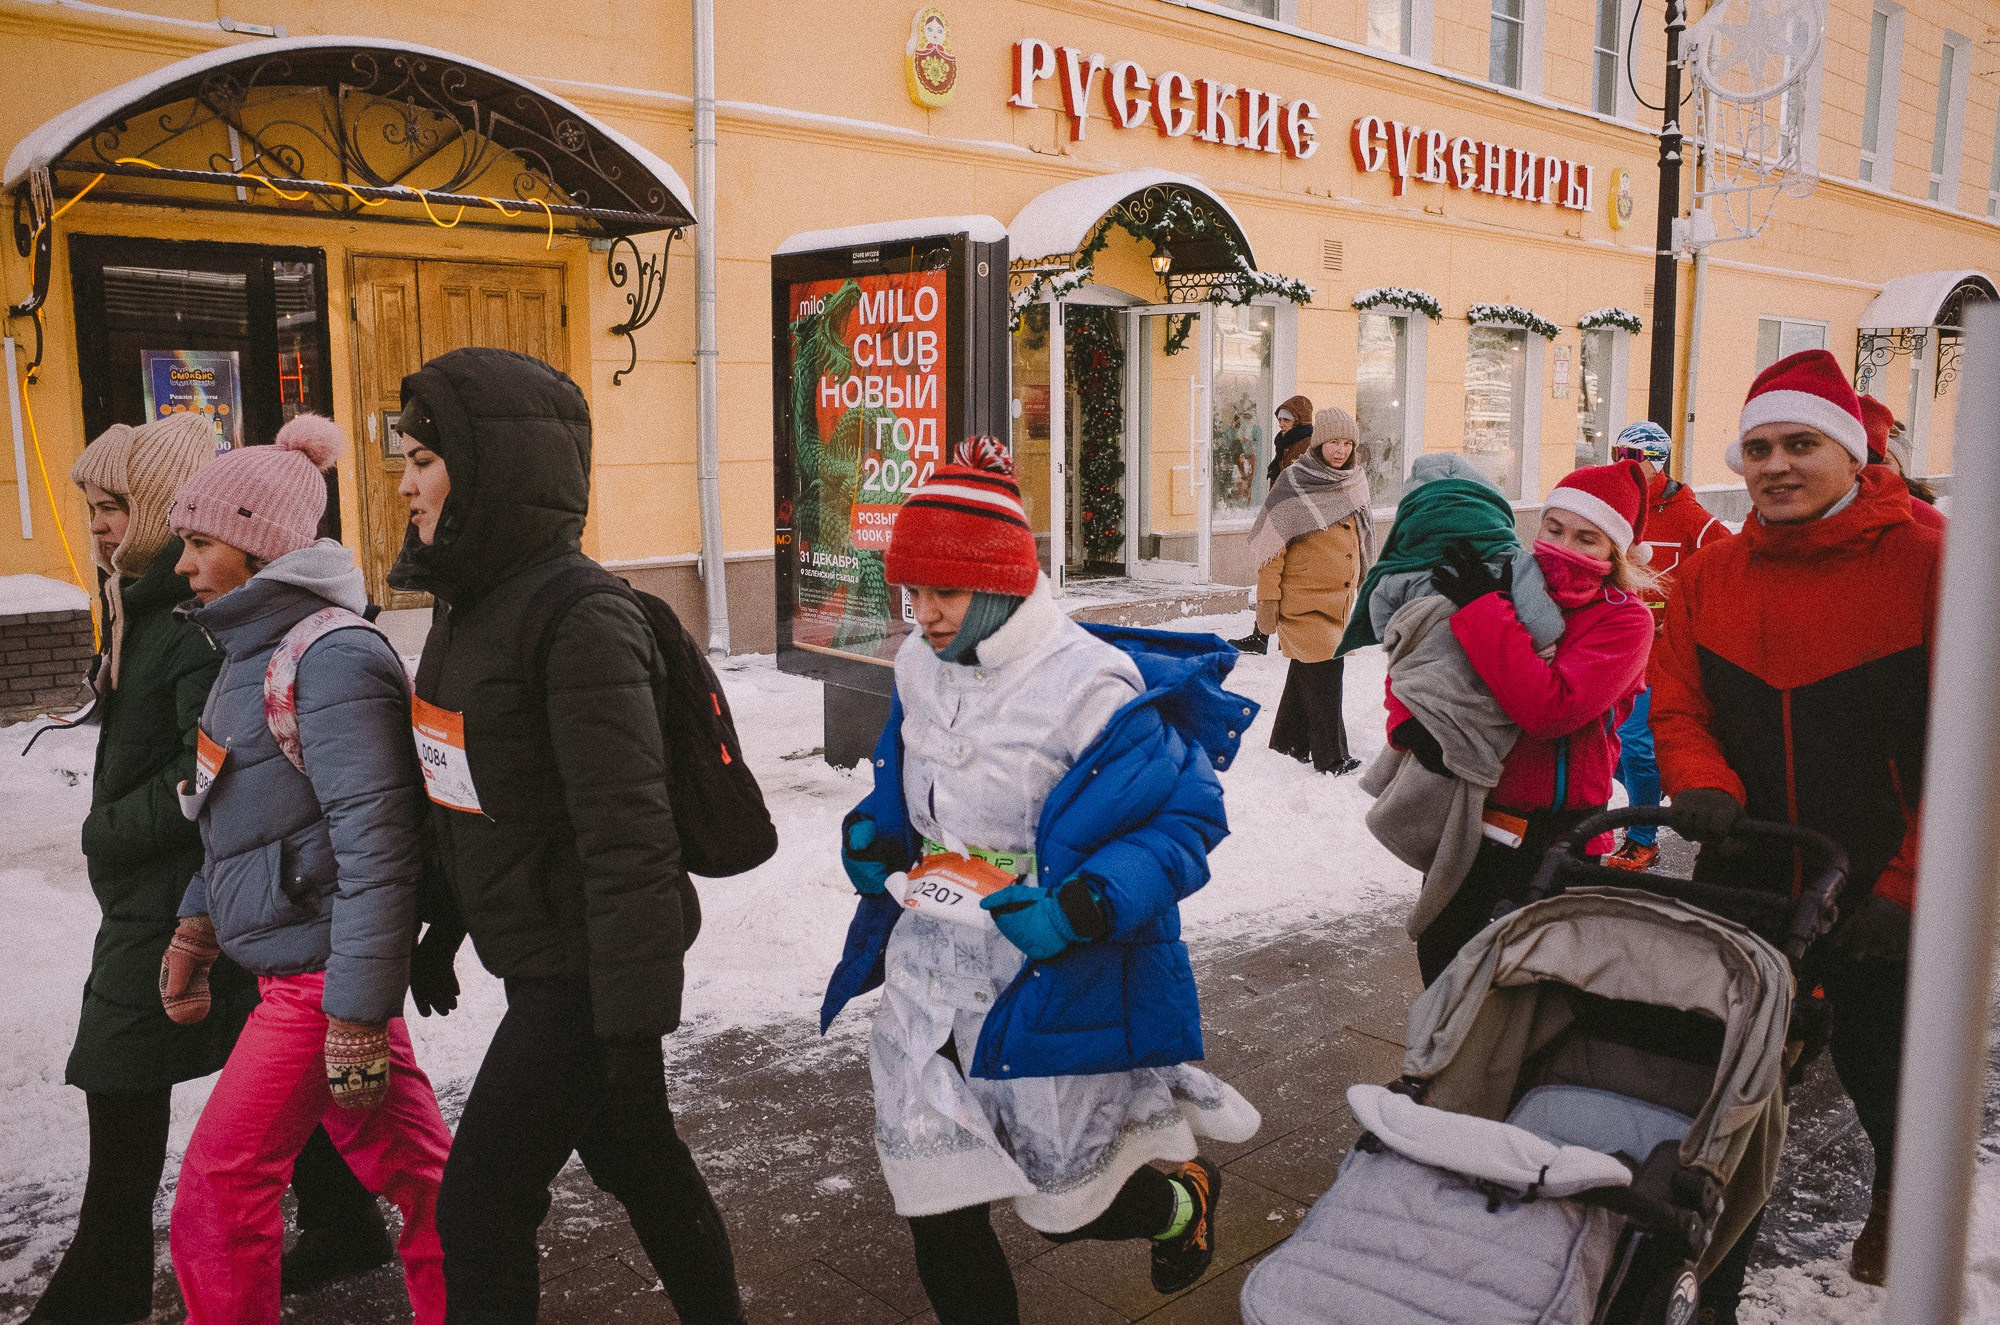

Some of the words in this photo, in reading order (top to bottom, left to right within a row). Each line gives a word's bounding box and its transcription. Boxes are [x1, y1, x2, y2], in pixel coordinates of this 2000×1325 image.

[1007, 37, 1321, 160] РУССКИЕ
[1351, 115, 1595, 211] СУВЕНИРЫ
[799, 295, 825, 316] milo
[859, 286, 939, 325] MILO
[853, 331, 939, 367] CLUB
[821, 365, 937, 409] НОВЫЙ
[876, 417, 939, 460] ГОД
[858, 512, 899, 526] РОЗЫГ
[800, 551, 810, 563] 31
[813, 552, 859, 570] ДЕКАБРЯ
[913, 882, 963, 905] 0207
